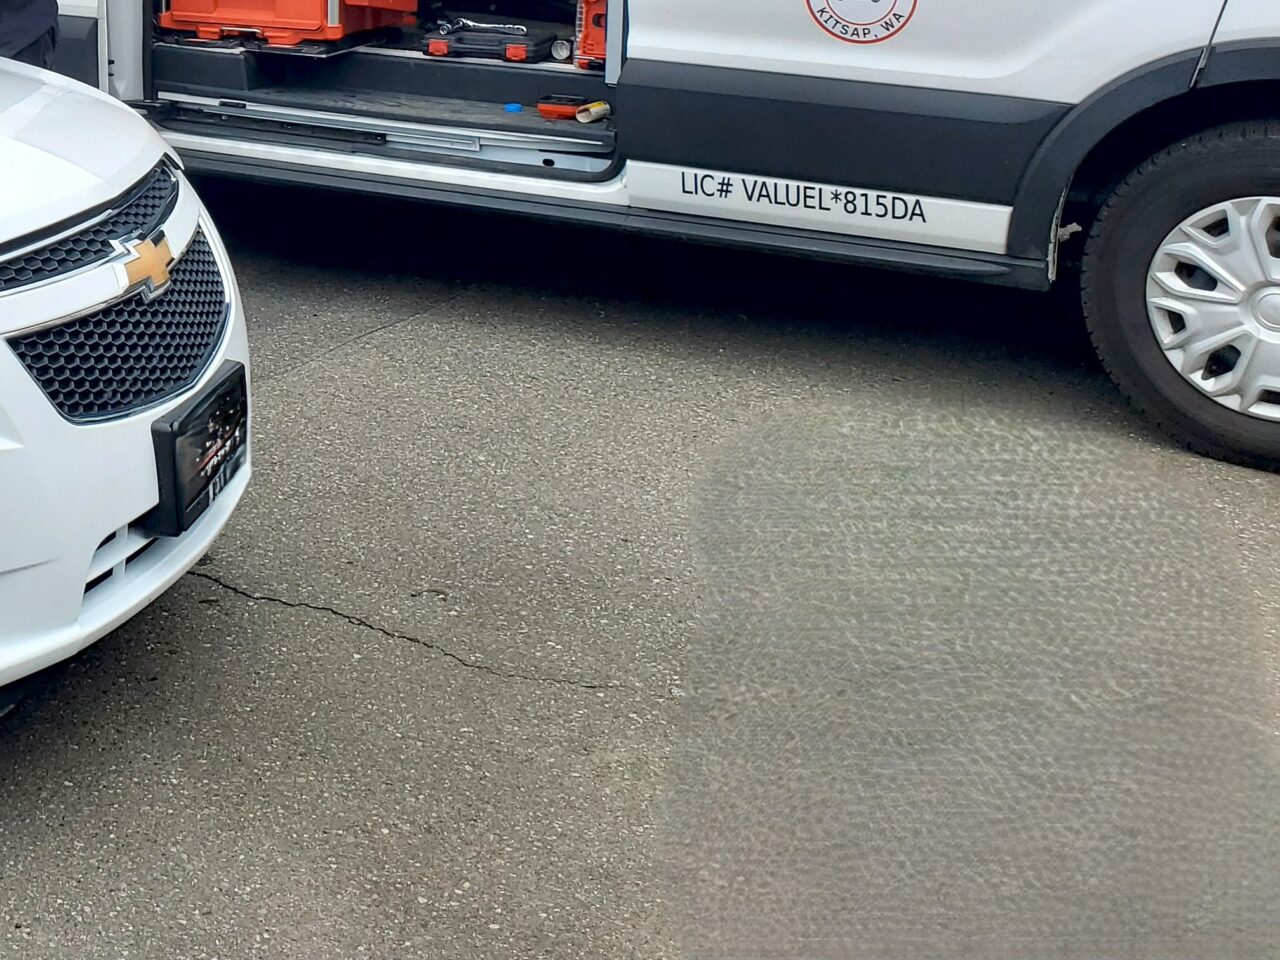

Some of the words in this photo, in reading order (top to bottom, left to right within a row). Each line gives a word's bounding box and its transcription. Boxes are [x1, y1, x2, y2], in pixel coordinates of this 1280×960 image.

[817, 7, 878, 39] KITSAP,
[880, 12, 905, 32] WA
[681, 171, 733, 199] LIC#
